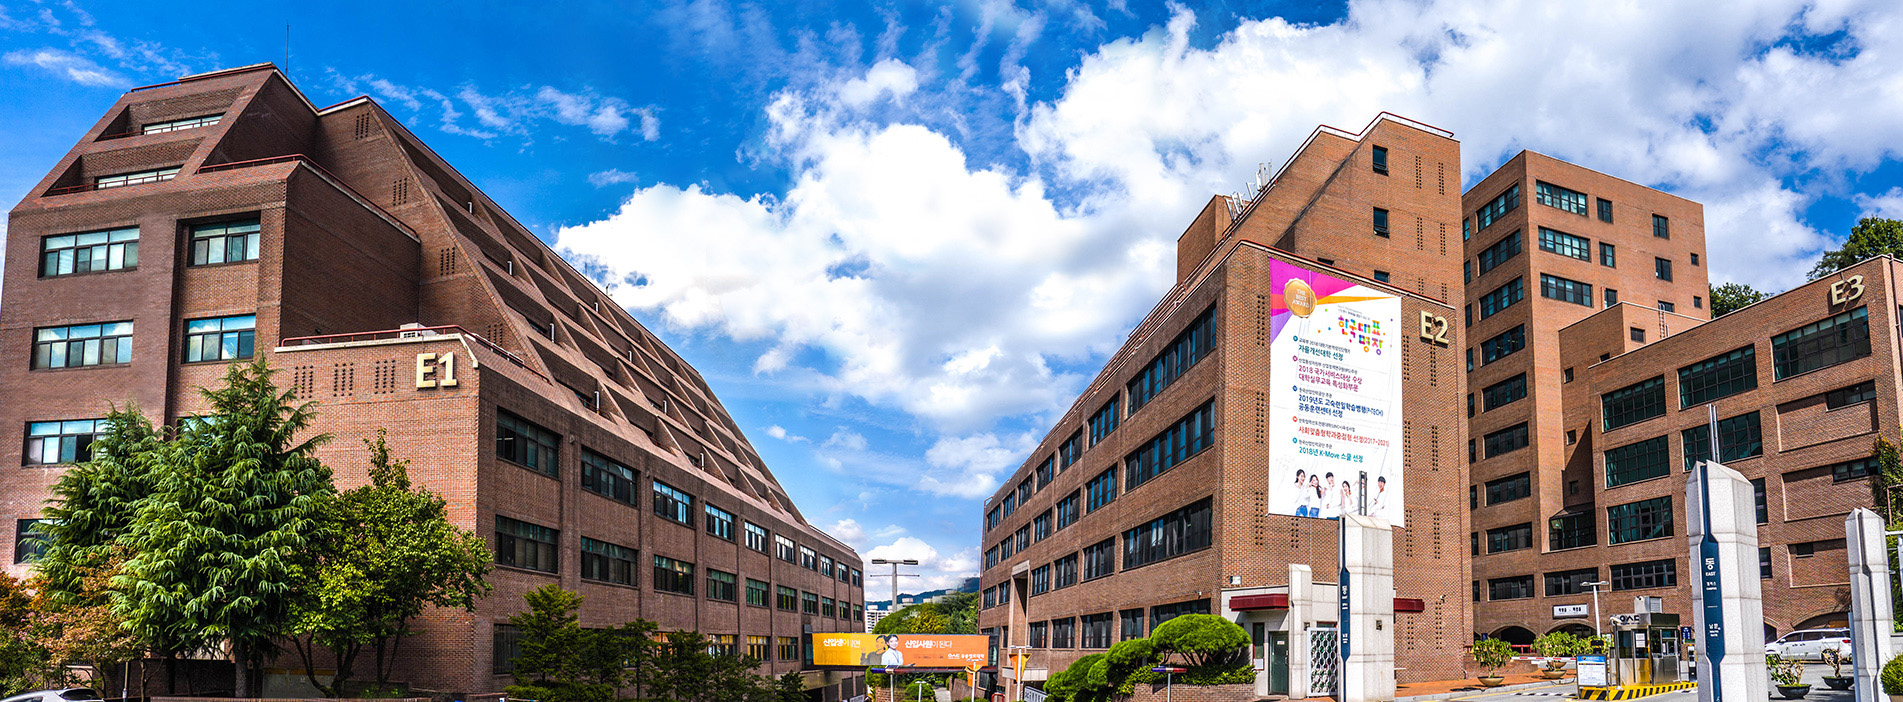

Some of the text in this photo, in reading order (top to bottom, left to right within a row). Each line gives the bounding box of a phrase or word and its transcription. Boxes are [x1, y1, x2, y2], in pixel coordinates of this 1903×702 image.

[1830, 274, 1865, 306] E3
[1338, 315, 1380, 339] 한국대표
[1420, 310, 1449, 345] E2
[1298, 344, 1343, 361] 자율개선대학 선정
[1358, 335, 1383, 355] 명장
[416, 352, 458, 388] E1
[1299, 364, 1363, 385] 2018 국가서비스대상 수상
[1298, 373, 1332, 386] 대학실무교육
[1298, 394, 1324, 405] 2019년도
[1298, 404, 1343, 418] 공동훈련센터 선정
[1299, 446, 1363, 463] 2018년 K-Move 스쿨 선정
[1706, 558, 1715, 570] 동
[905, 640, 952, 648] 신입사원이 된다
